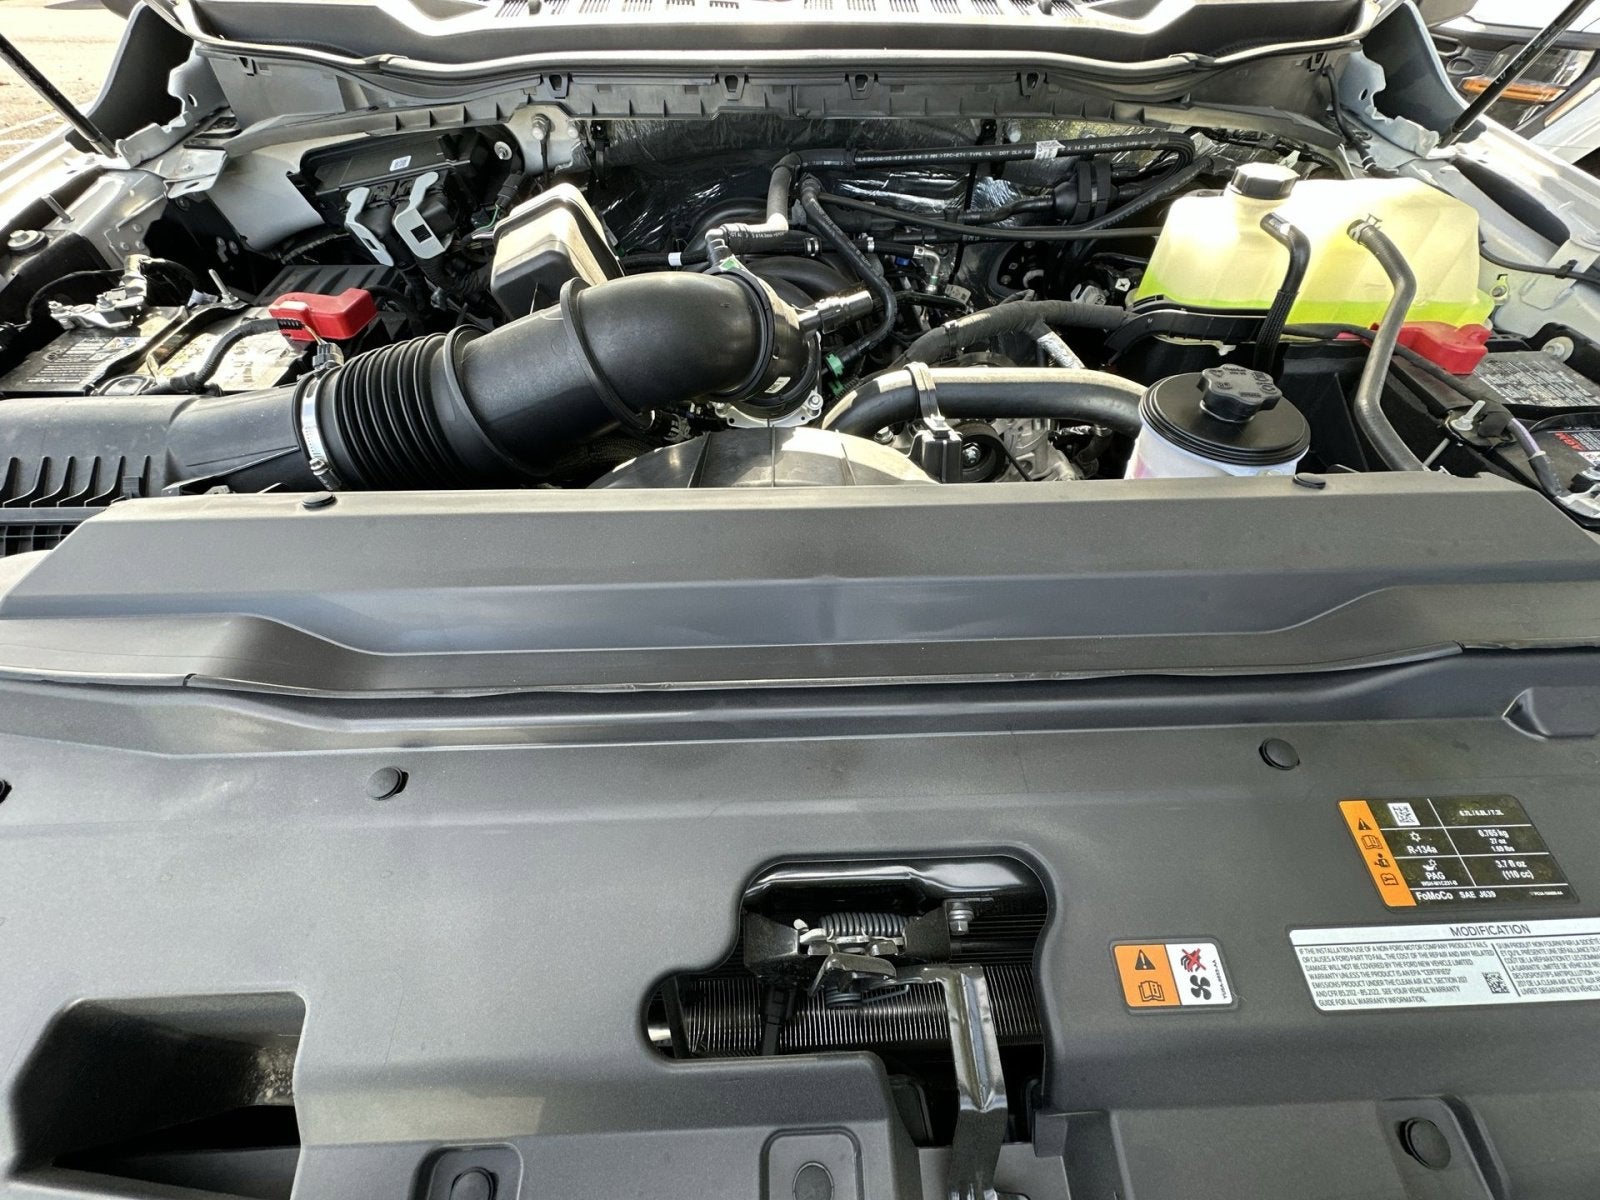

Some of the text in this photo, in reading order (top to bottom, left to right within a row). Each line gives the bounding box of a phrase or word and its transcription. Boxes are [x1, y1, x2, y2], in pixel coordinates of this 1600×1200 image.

[1499, 830, 1509, 838] kg
[1407, 846, 1438, 854] R-134a
[1495, 860, 1507, 868] 3.7
[1507, 860, 1515, 868] fl
[1425, 872, 1446, 880] PAG
[1502, 869, 1535, 880] (110 cc)
[1416, 891, 1453, 900] FoMoCo
[1459, 891, 1476, 899] SAE
[1450, 924, 1531, 937] MODIFICATION
